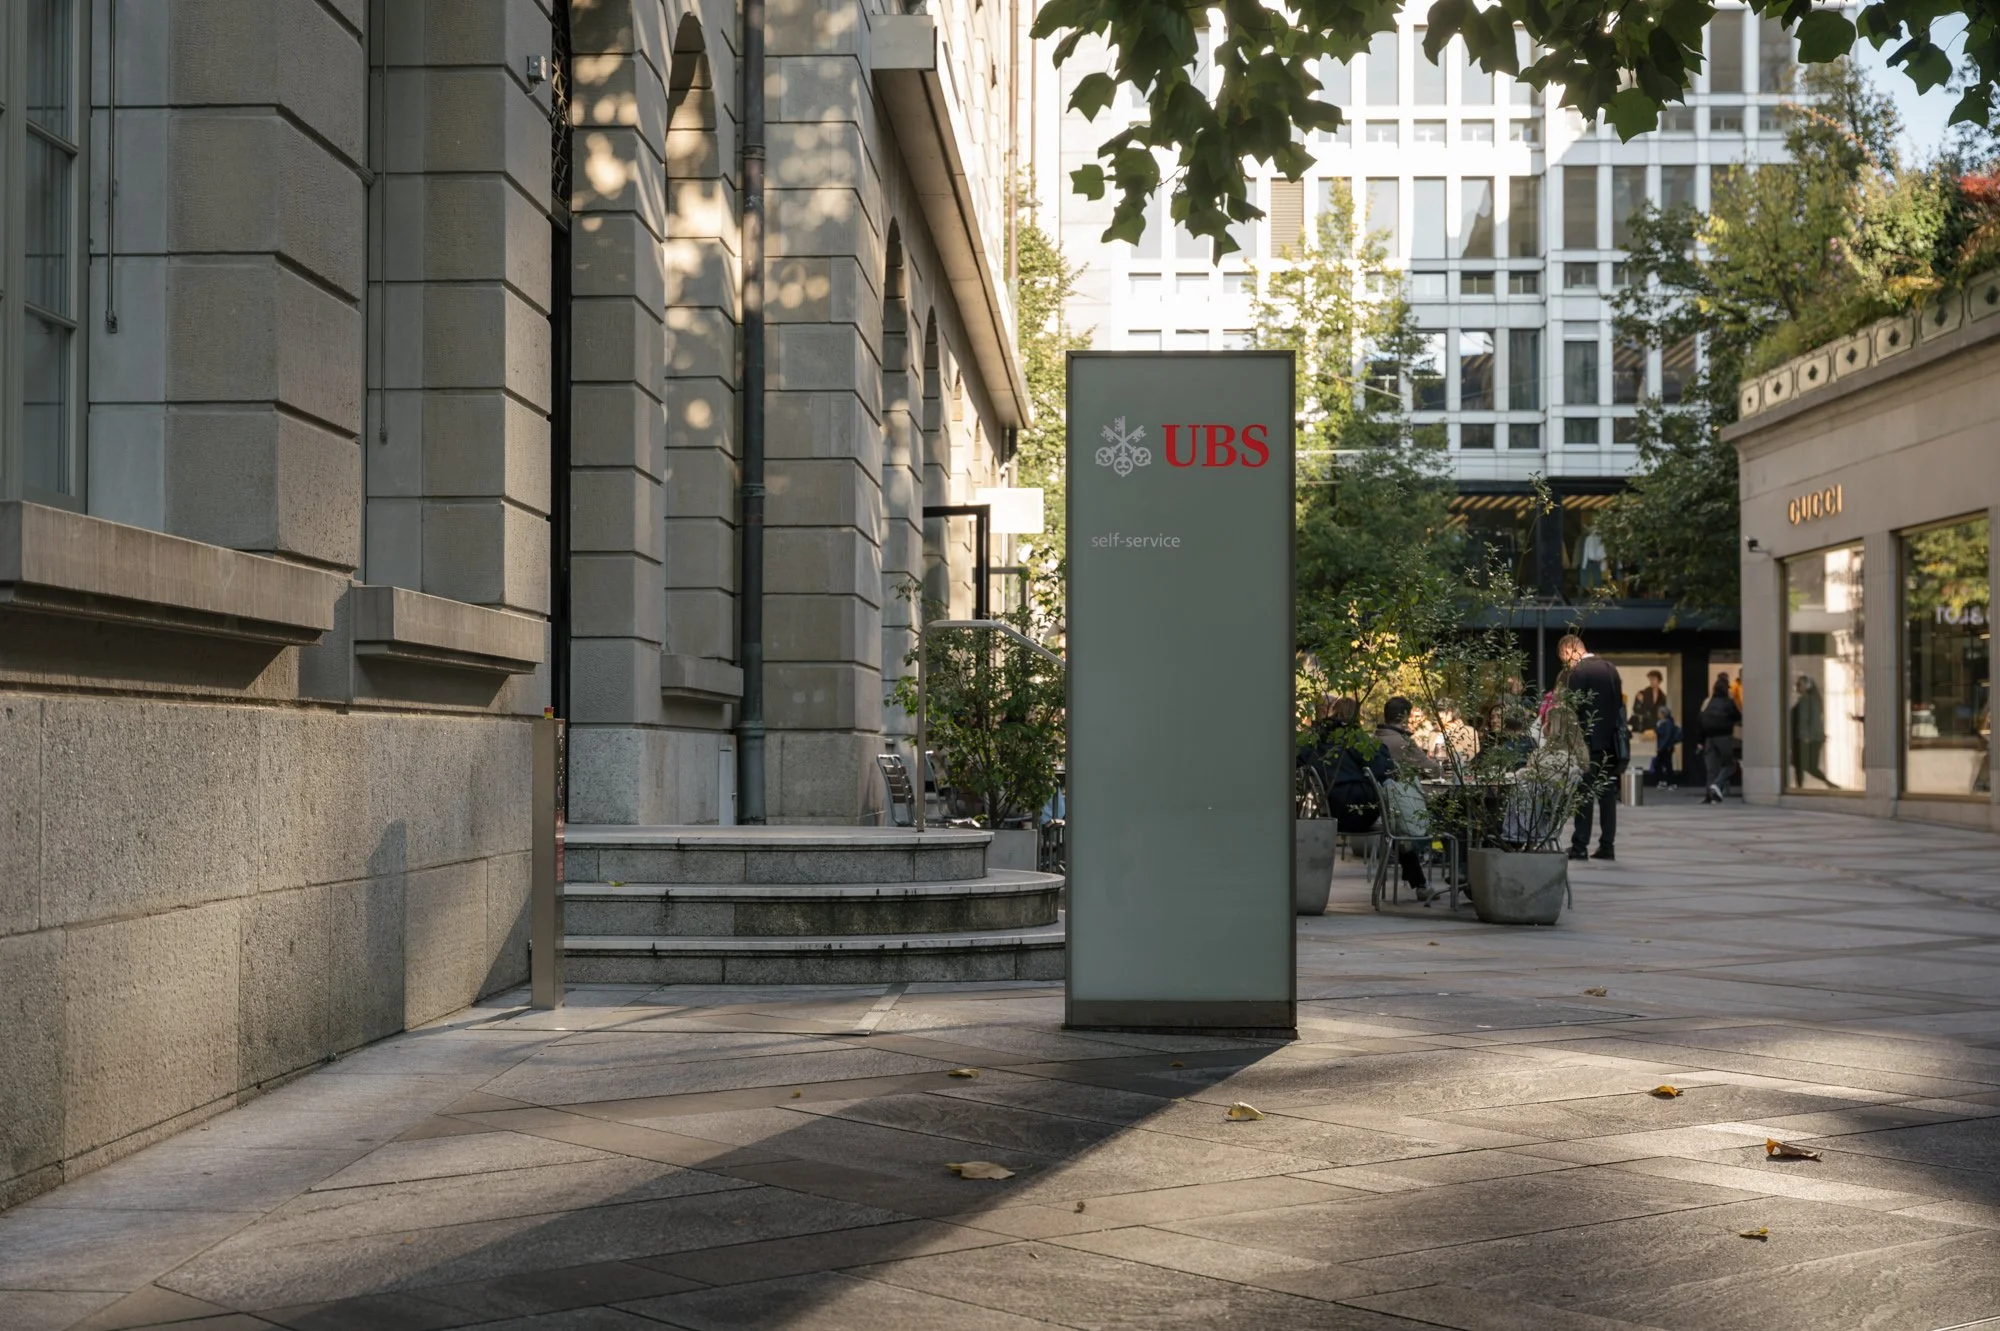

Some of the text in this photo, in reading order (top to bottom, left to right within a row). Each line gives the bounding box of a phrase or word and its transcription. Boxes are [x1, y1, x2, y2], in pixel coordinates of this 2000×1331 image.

[1161, 423, 1270, 468] UBS
[1788, 484, 1842, 526] GUCCI
[1091, 531, 1181, 548] self-service
